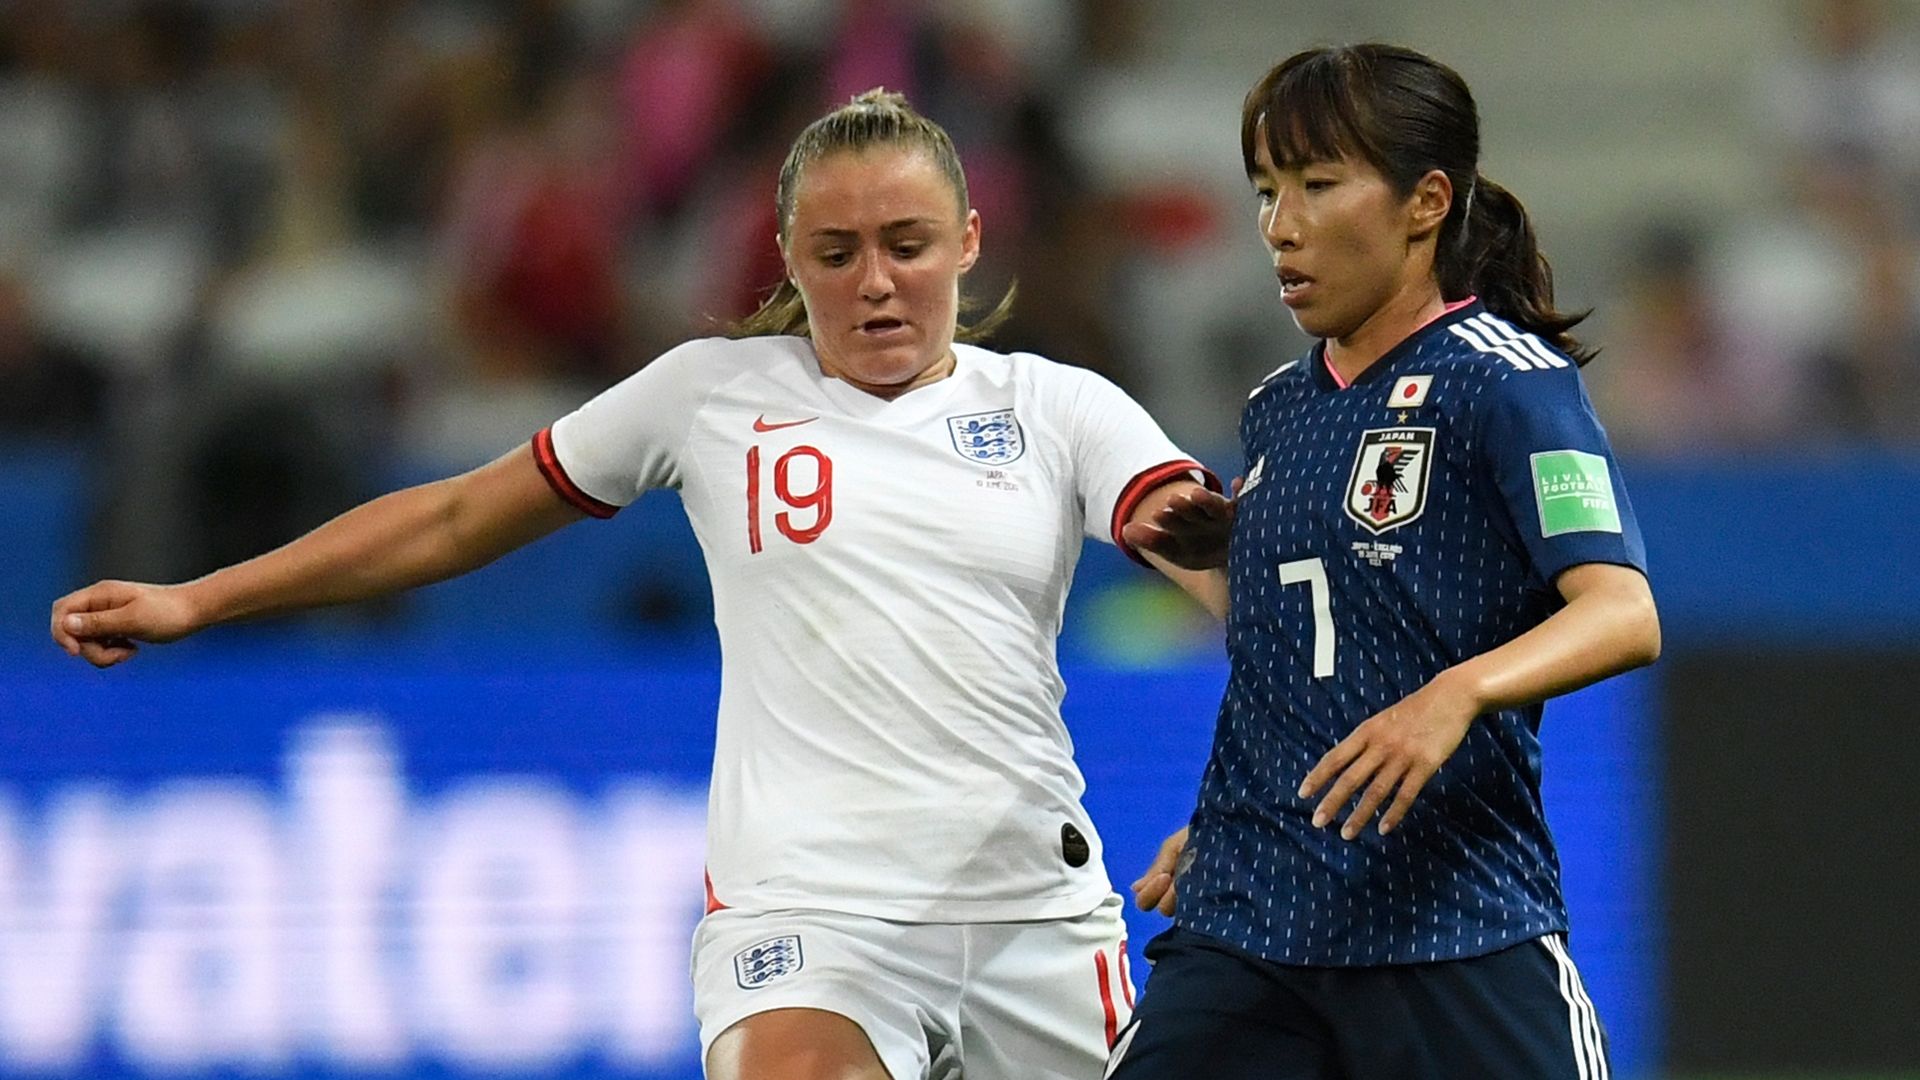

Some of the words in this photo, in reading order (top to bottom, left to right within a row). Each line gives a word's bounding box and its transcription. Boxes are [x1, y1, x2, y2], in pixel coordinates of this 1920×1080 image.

[1379, 432, 1415, 442] JAPAN
[1543, 481, 1606, 495] FOOTBALL
[746, 445, 833, 554] 19
[1363, 498, 1397, 514] JFA
[1279, 557, 1334, 678] 7
